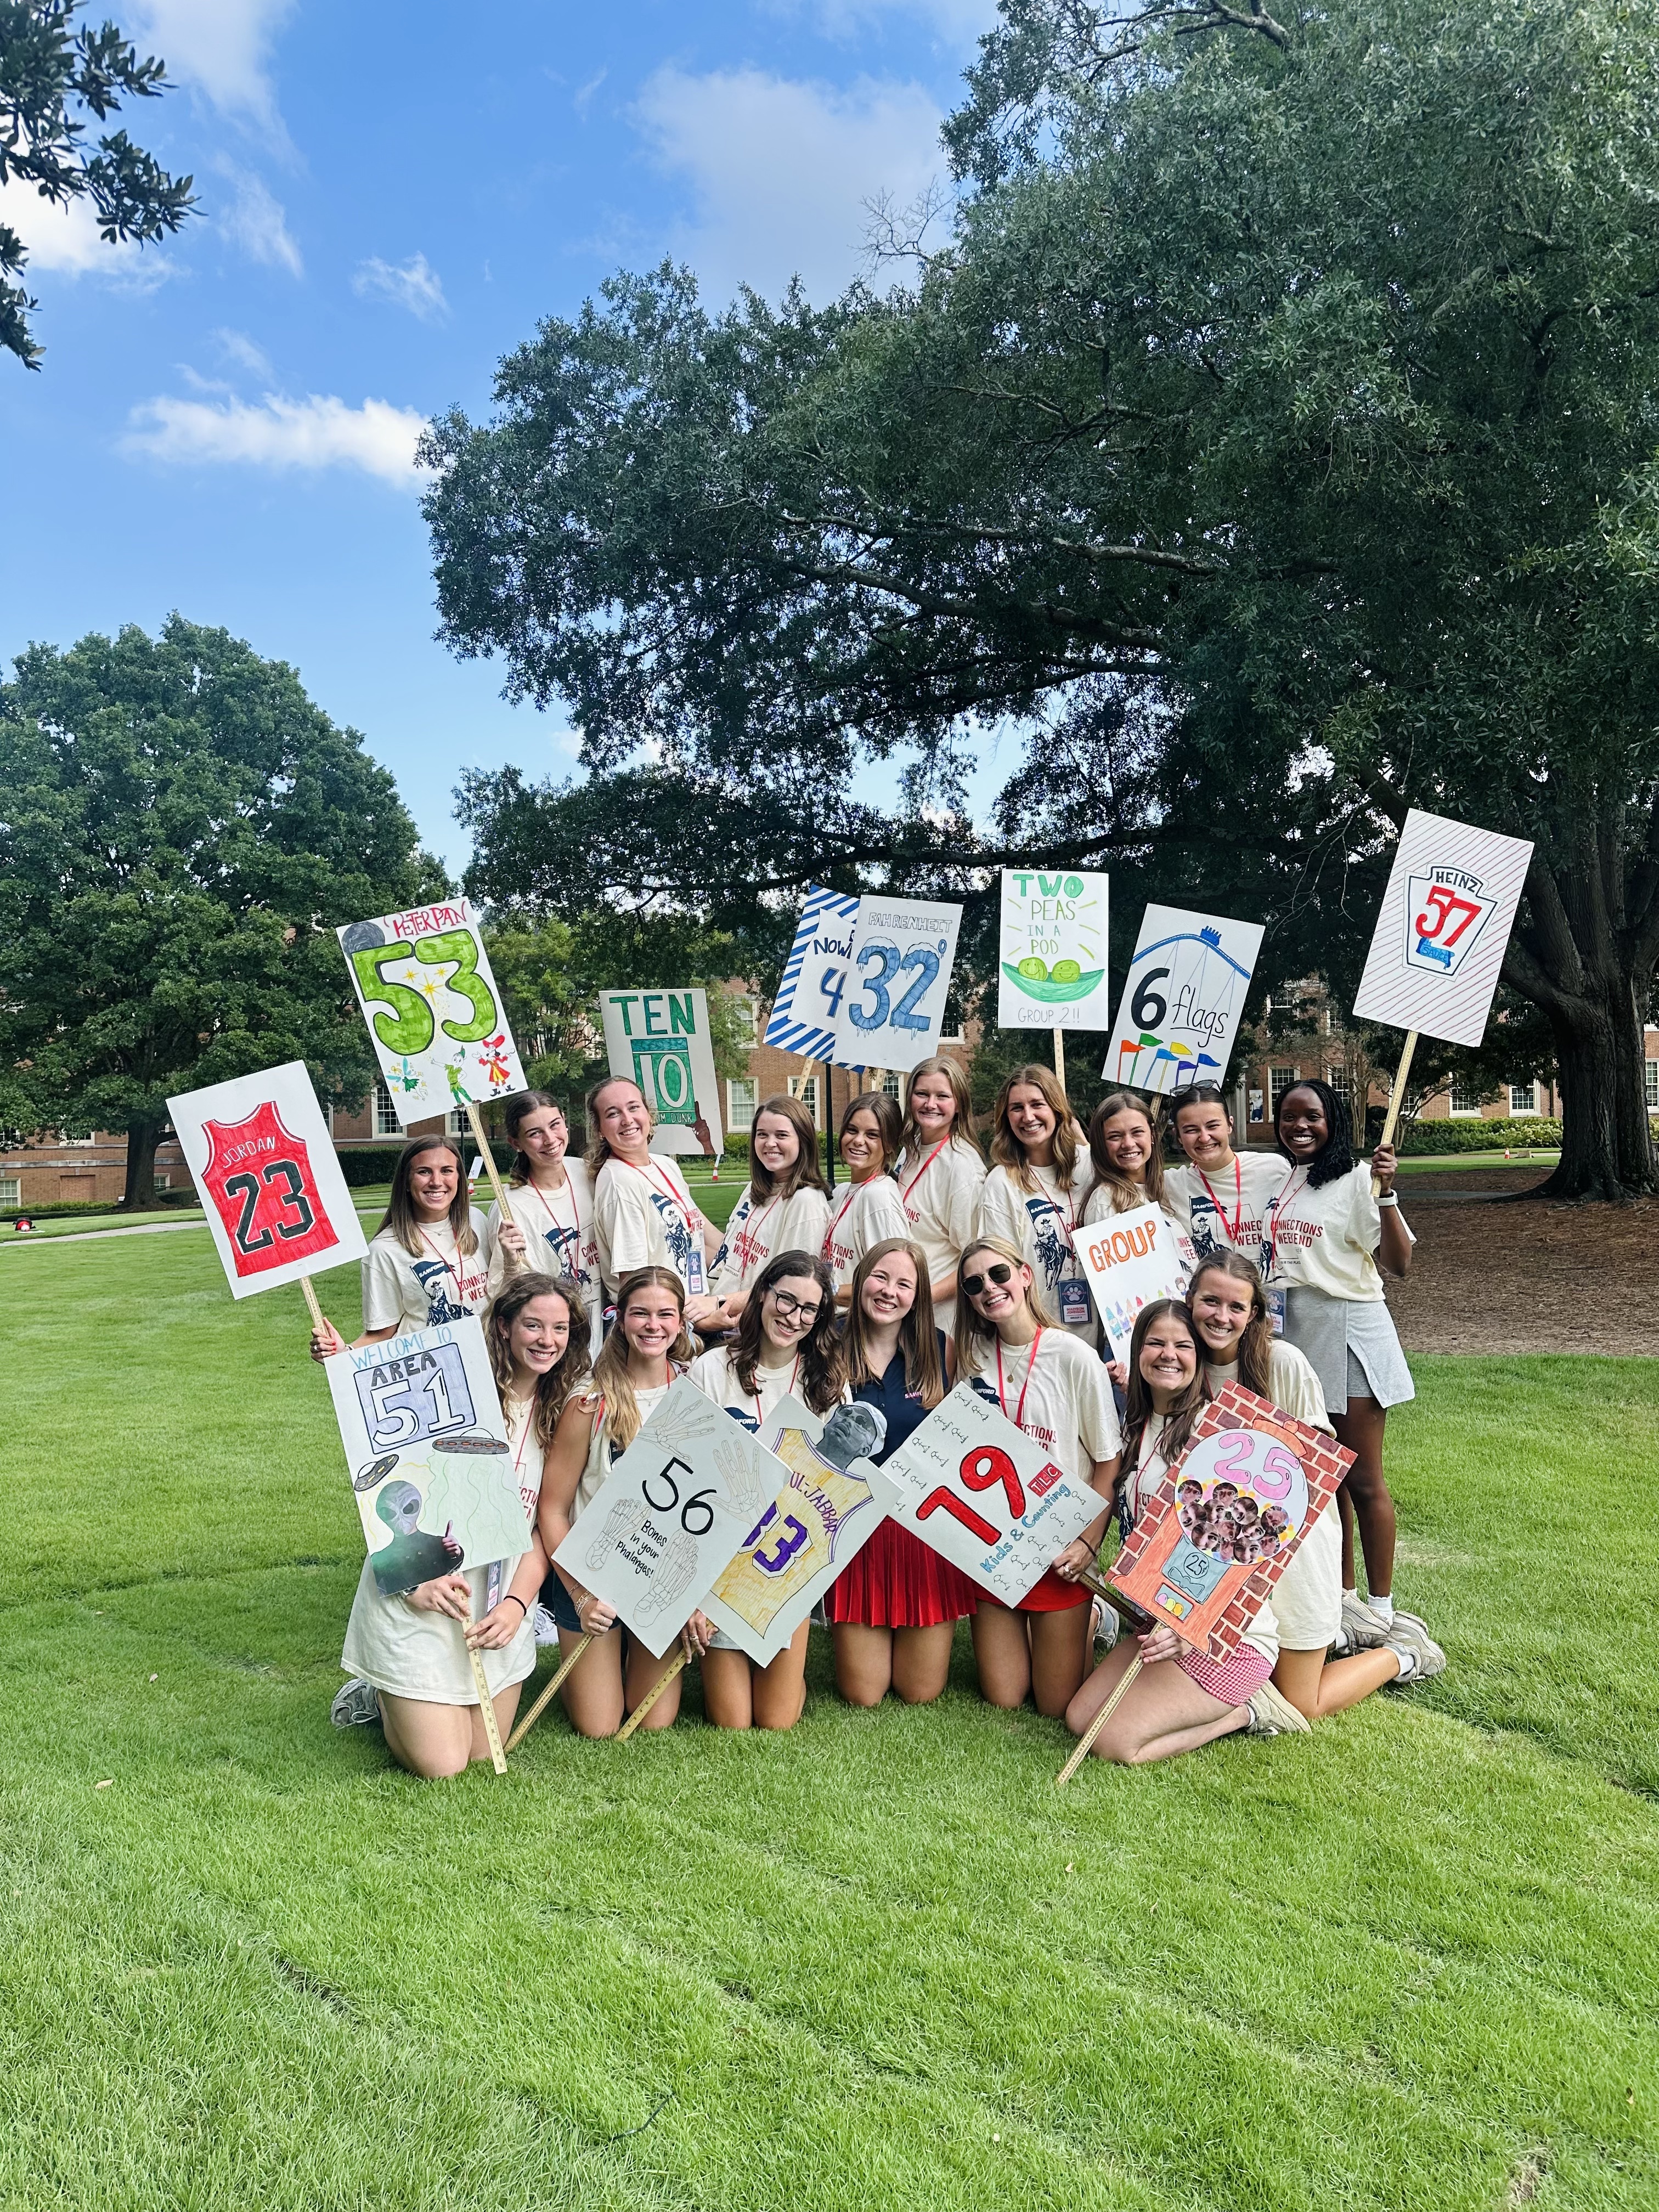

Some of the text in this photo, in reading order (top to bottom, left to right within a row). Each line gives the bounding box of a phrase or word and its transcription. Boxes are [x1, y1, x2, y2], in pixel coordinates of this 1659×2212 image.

[1013, 874, 1084, 898] TWO
[1435, 871, 1478, 893] HEINZ
[384, 901, 467, 938] PETER PAN
[868, 912, 952, 933] FAHRENHEIT
[1031, 900, 1075, 921] PEAS
[1415, 885, 1482, 947] 57
[1028, 924, 1061, 936] IN A
[1031, 939, 1059, 955] POD
[1422, 946, 1448, 962] SAUCE
[351, 930, 497, 1056] 53
[1131, 968, 1229, 1048] 6 flags
[609, 994, 696, 1035] TEN
[1018, 1007, 1054, 1023] GROUP
[640, 1054, 688, 1108] 10
[657, 1113, 693, 1123] AM DUNK
[222, 1136, 276, 1169] JORDAN
[224, 1160, 315, 1256] 23
[1236, 1233, 1262, 1246] WEEK
[1271, 1219, 1323, 1238] CONNECTIONS
[1277, 1232, 1312, 1248] WEEKEND
[1089, 1220, 1156, 1272] GROUP
[419, 1262, 444, 1278] SAMFORD
[349, 1326, 452, 1370] WELCOME TO
[371, 1352, 437, 1387] AREA
[370, 1368, 465, 1446] 51
[1031, 1466, 1058, 1492] TLC
[1214, 1432, 1300, 1500] 25
[642, 1457, 716, 1536] 56
[790, 1471, 839, 1537] UL-JABBAR
[916, 1445, 1026, 1547] 19
[641, 1519, 667, 1547] Bones
[979, 1483, 1071, 1573] Kids & Counting
[637, 1542, 659, 1559] your
